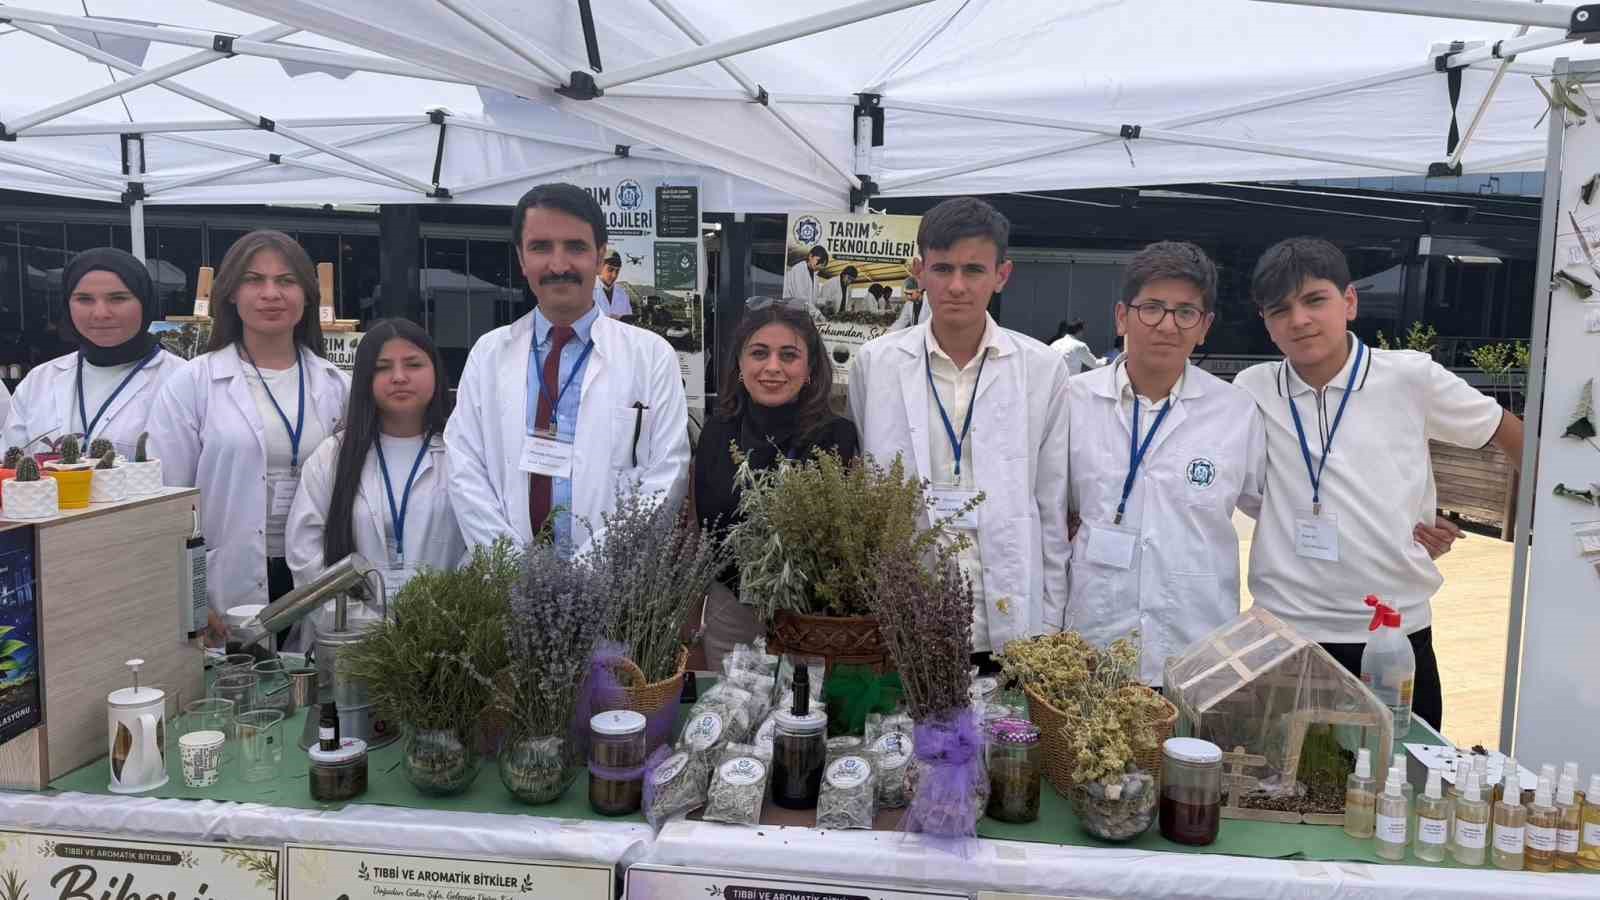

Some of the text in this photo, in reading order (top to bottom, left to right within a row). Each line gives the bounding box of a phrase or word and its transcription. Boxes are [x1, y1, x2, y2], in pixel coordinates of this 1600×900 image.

[584, 187, 610, 206] RIM
[829, 221, 870, 239] TARIM
[827, 238, 915, 257] TEKNOLOJİLERİ
[322, 338, 344, 351] RIM
[1, 705, 30, 726] ASYONU
[64, 847, 83, 857] TIBBİ
[84, 848, 95, 857] VE
[96, 849, 137, 860] AROMATİK
[373, 866, 518, 888] TIBBİ VE AROMATİK BİTKİLER
[733, 889, 756, 900] TIBBİ
[759, 890, 770, 900] VE
